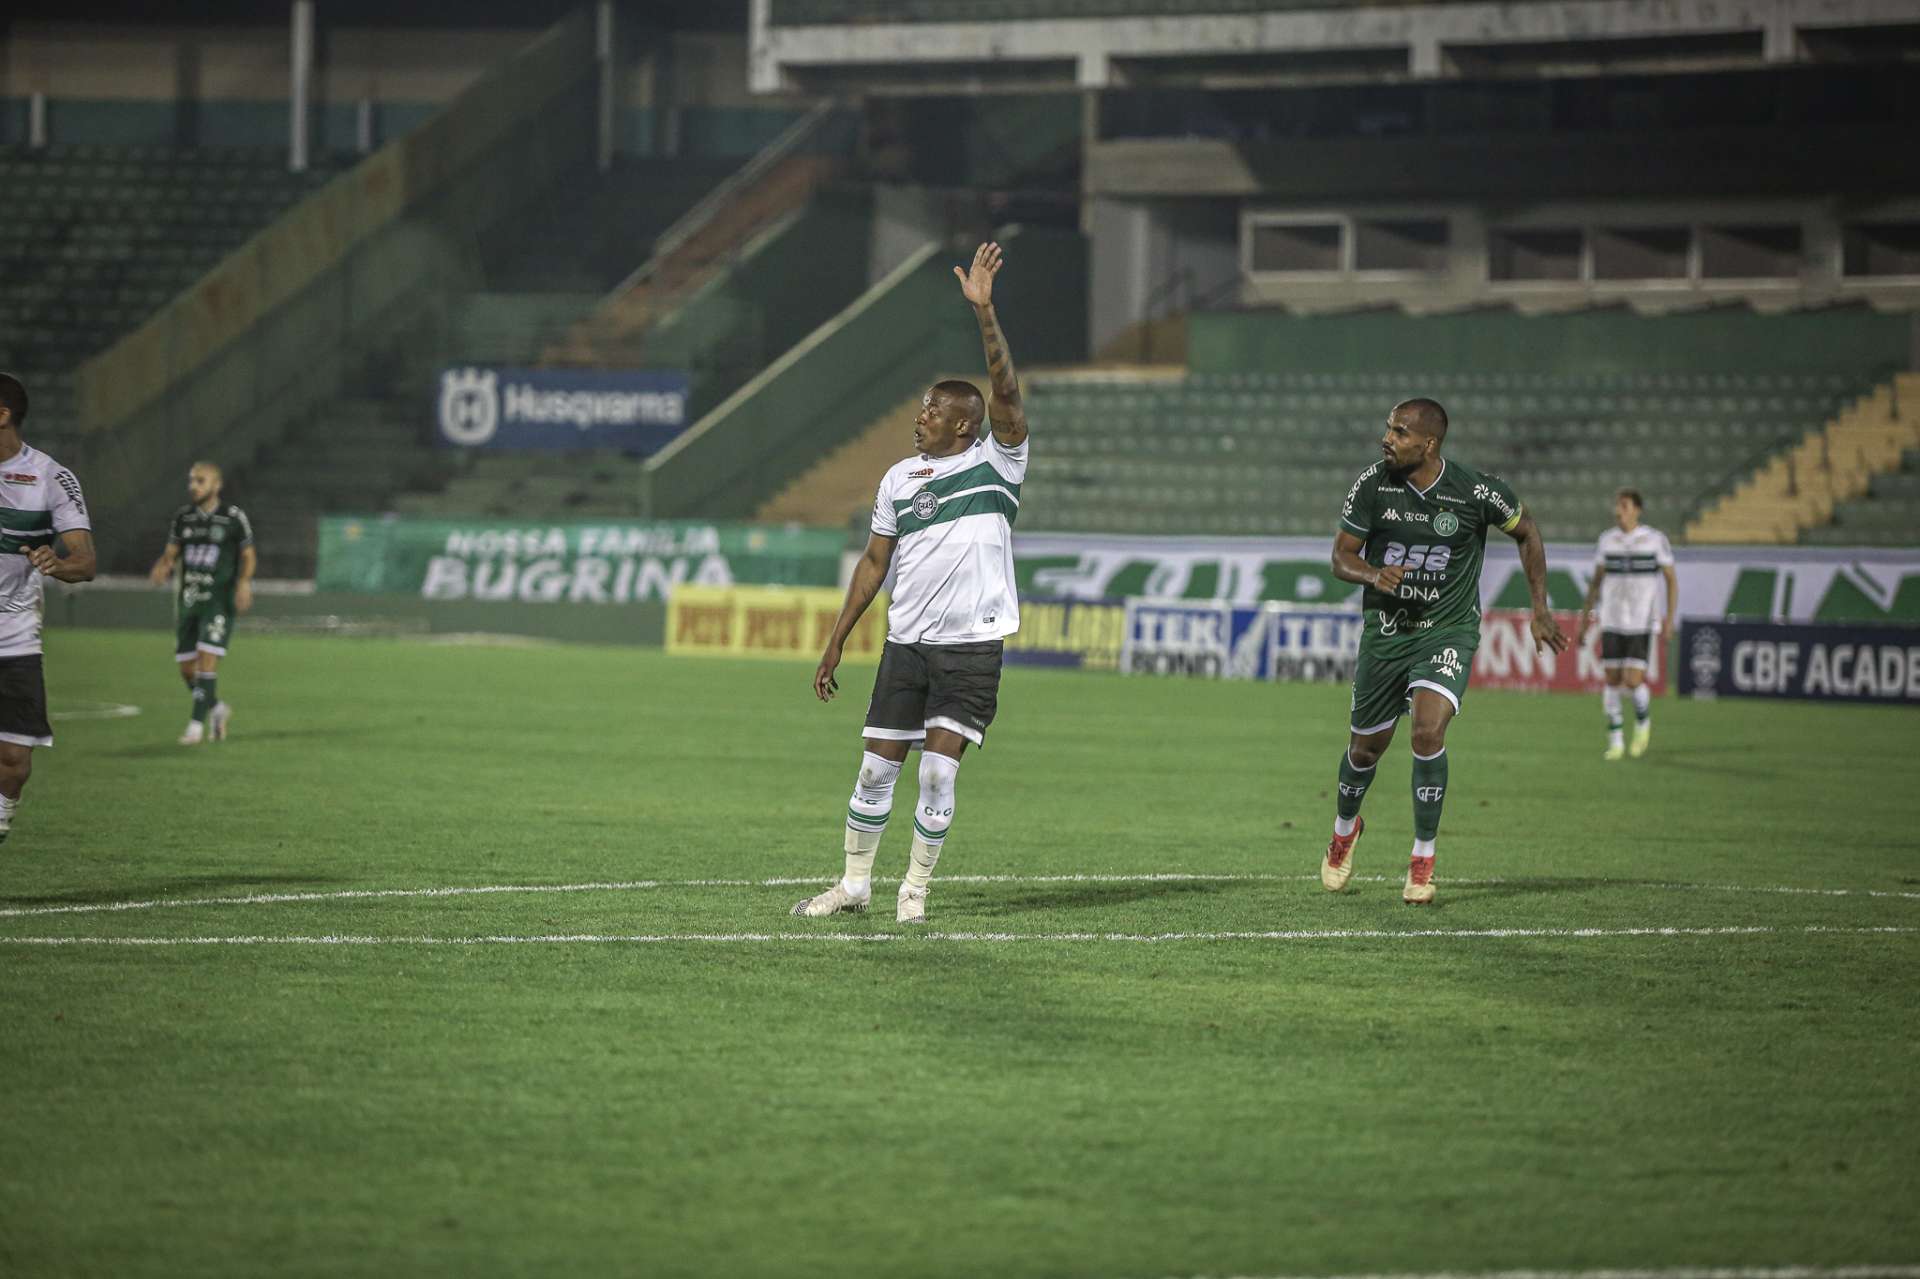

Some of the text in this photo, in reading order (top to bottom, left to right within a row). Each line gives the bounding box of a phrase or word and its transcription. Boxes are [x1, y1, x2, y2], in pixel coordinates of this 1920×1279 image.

[504, 384, 683, 430] Husqvarna
[445, 528, 567, 556] NOSSA
[422, 555, 735, 603] BUGRINA
[1400, 585, 1440, 601] DNA
[1732, 641, 1798, 688] CBF
